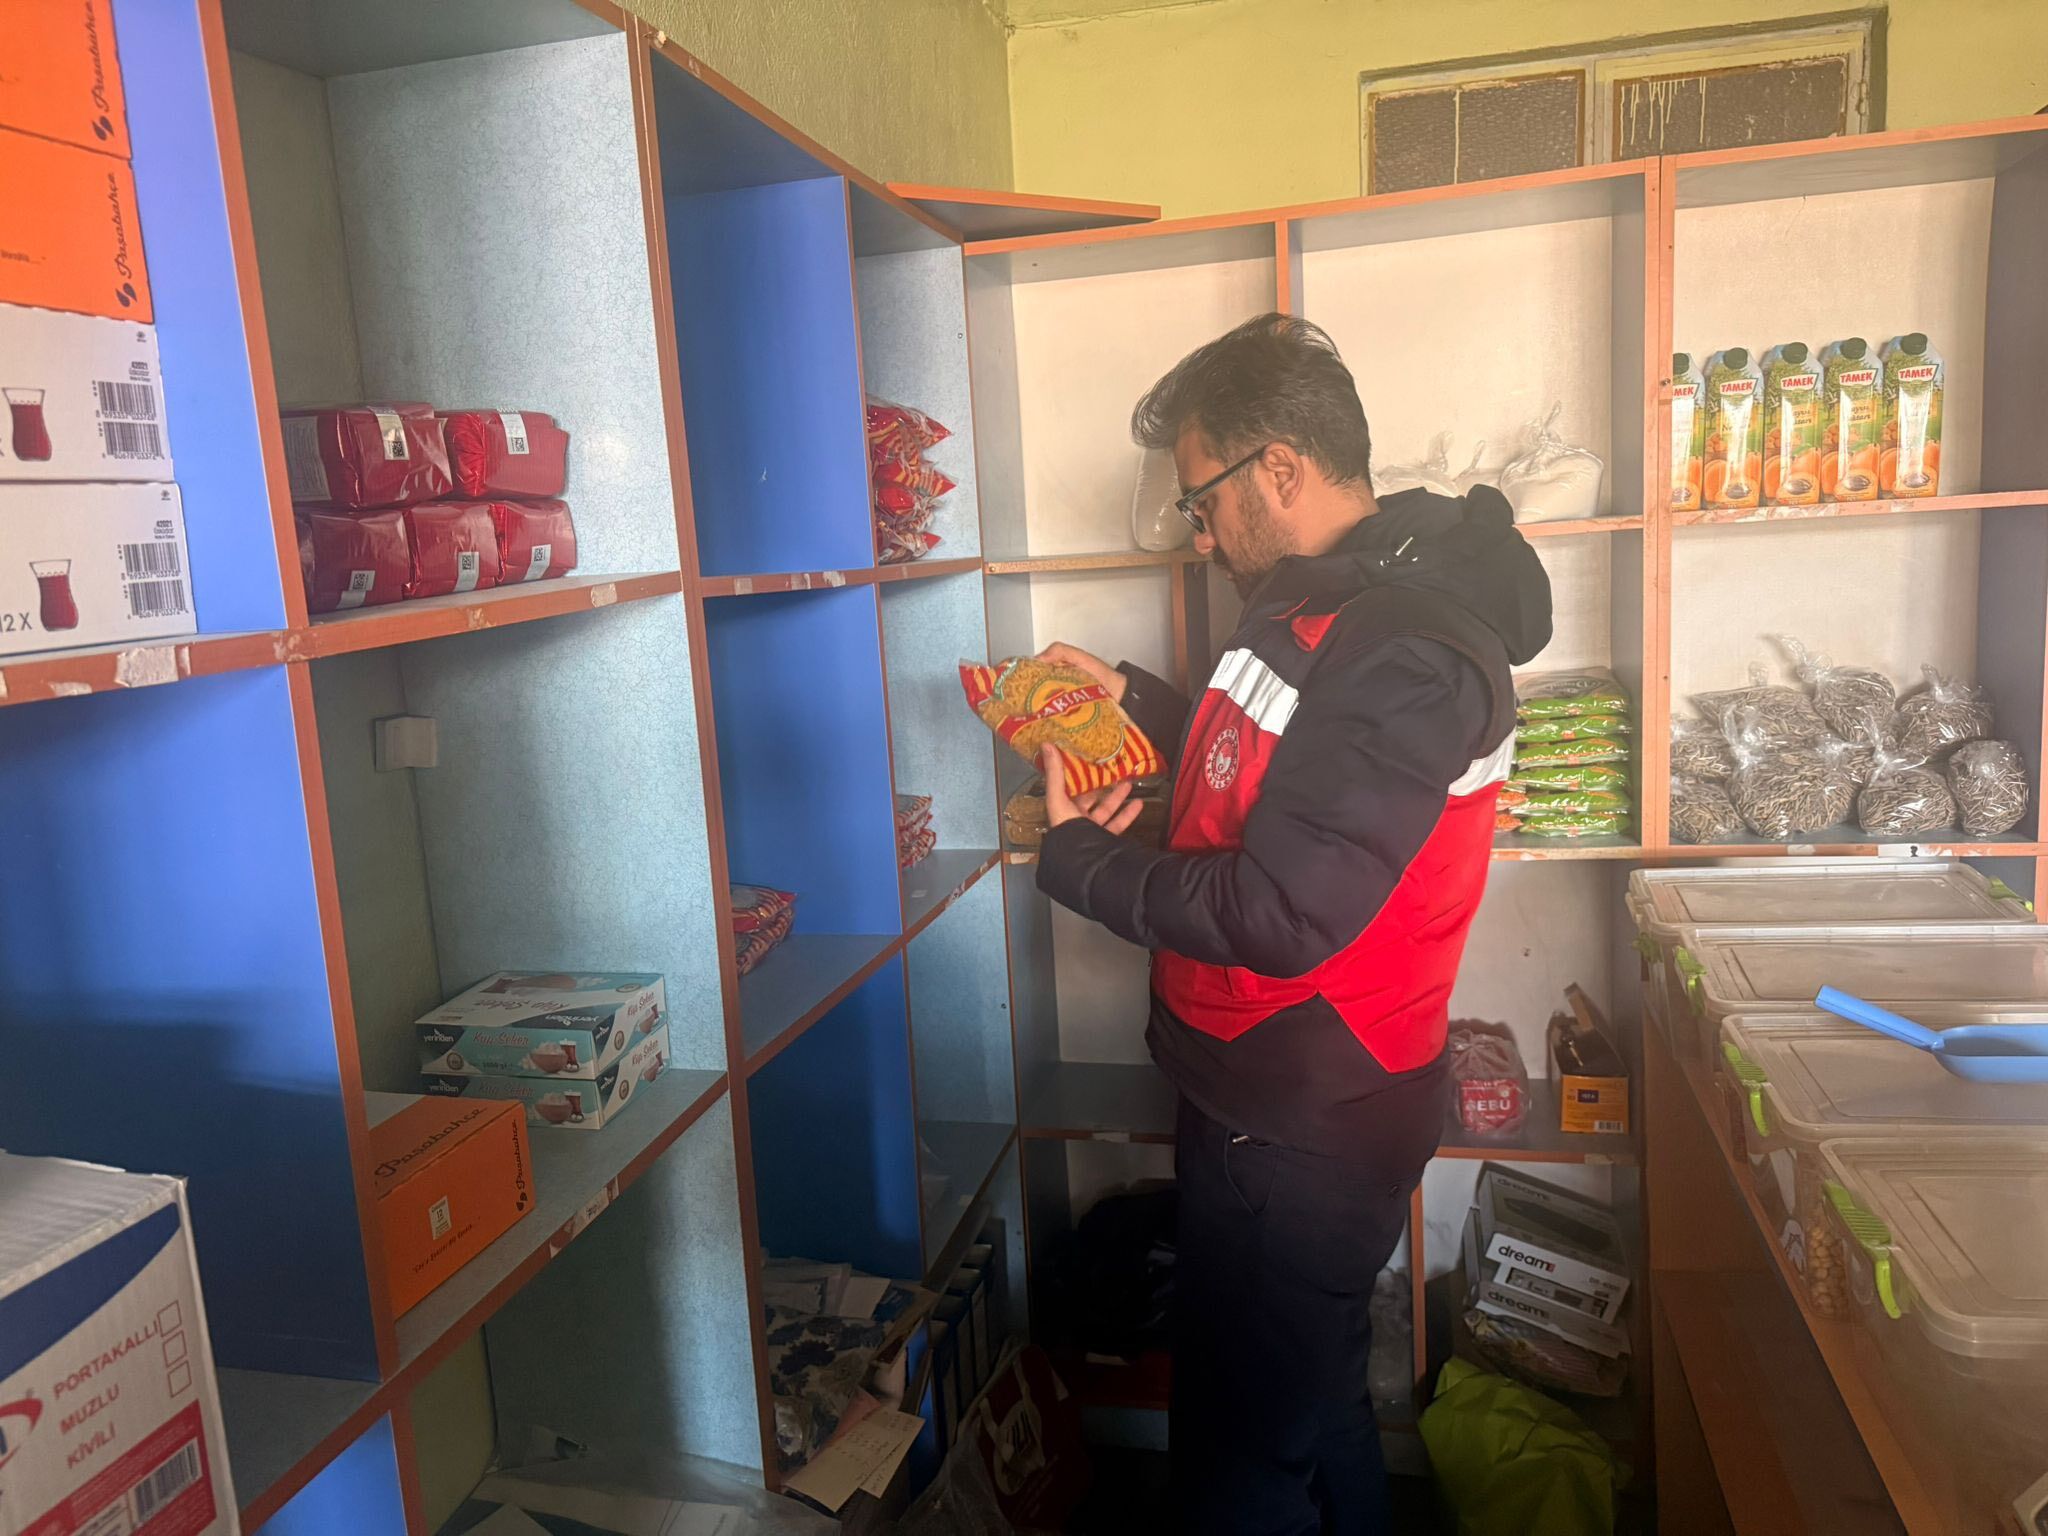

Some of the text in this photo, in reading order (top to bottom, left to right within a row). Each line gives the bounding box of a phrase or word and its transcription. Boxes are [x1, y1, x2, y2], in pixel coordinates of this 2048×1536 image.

[1840, 372, 1873, 383] TAMEK
[1900, 368, 1933, 379] TAMEK
[1721, 381, 1753, 393] TAMEK
[1782, 376, 1814, 388] TAMEK
[1673, 386, 1694, 397] MEK
[19, 612, 33, 631] X
[53, 1320, 158, 1400] PORTAKALLI
[59, 1384, 120, 1434] MUZLU
